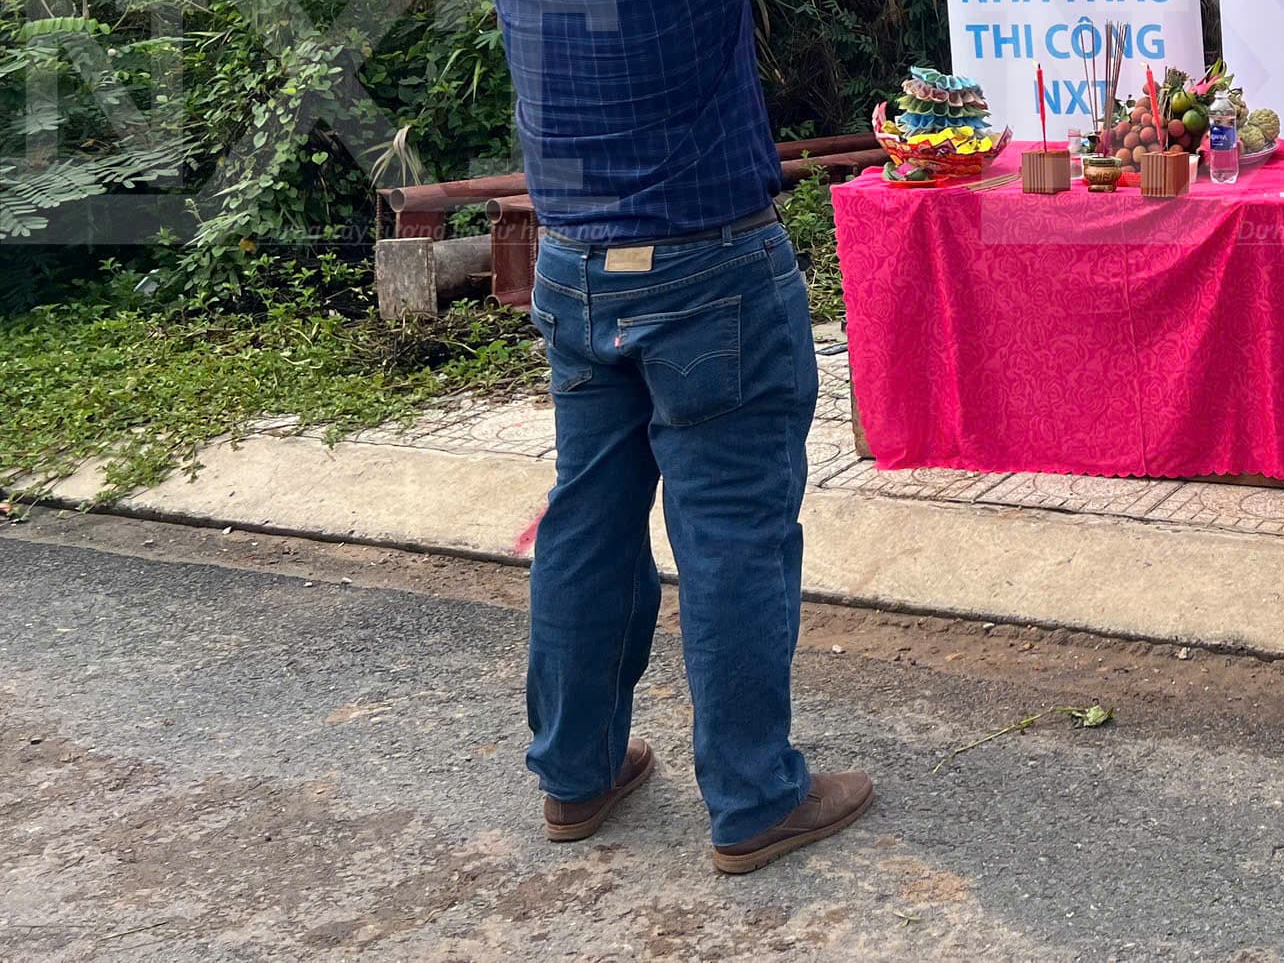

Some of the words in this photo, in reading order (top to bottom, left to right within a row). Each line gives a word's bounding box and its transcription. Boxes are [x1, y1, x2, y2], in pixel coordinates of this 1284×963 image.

[965, 24, 1034, 59] THI
[1045, 16, 1166, 60] CÔNG
[1034, 80, 1113, 115] NXT
